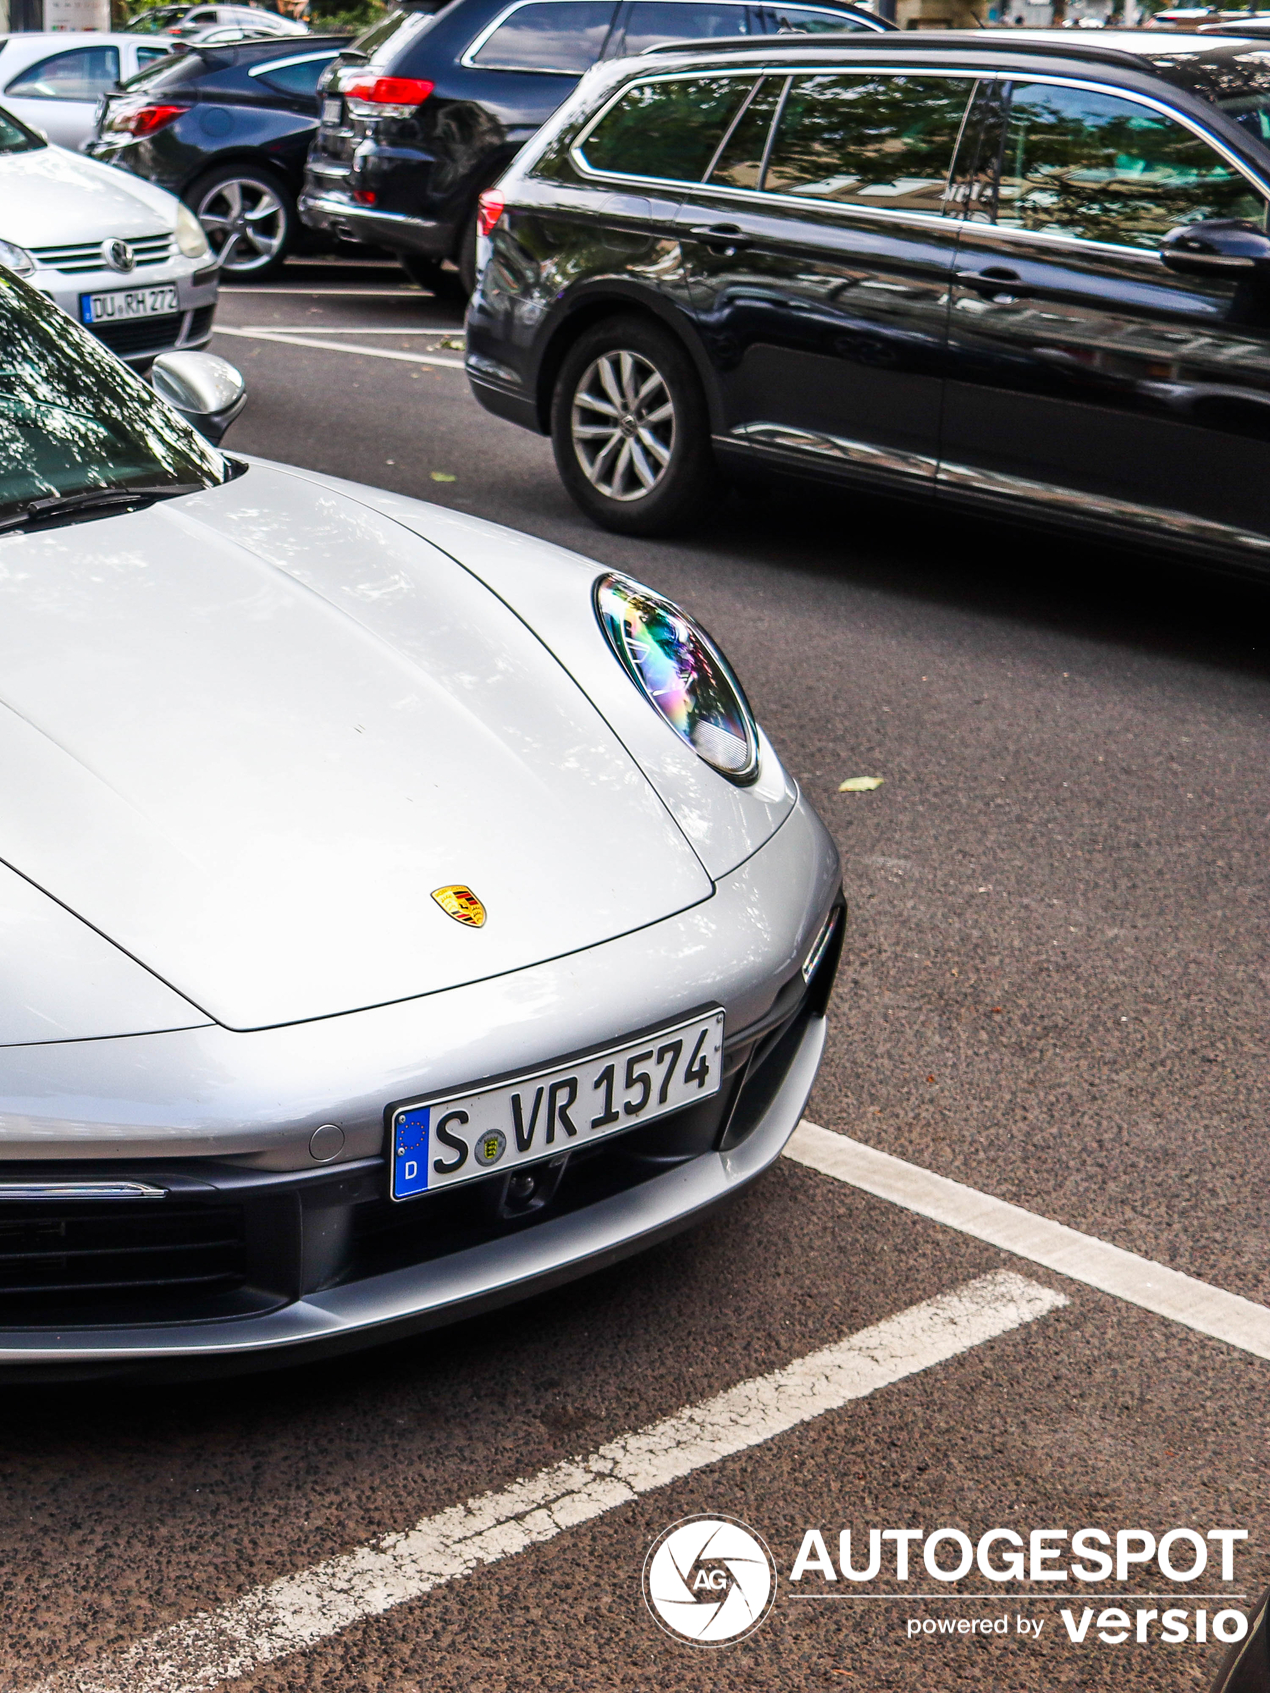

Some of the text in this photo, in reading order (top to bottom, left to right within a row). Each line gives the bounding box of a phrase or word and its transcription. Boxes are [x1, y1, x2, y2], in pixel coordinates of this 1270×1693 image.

[93, 288, 178, 318] DU RH 272
[433, 1028, 710, 1174] S VR 1574
[404, 1160, 418, 1180] D
